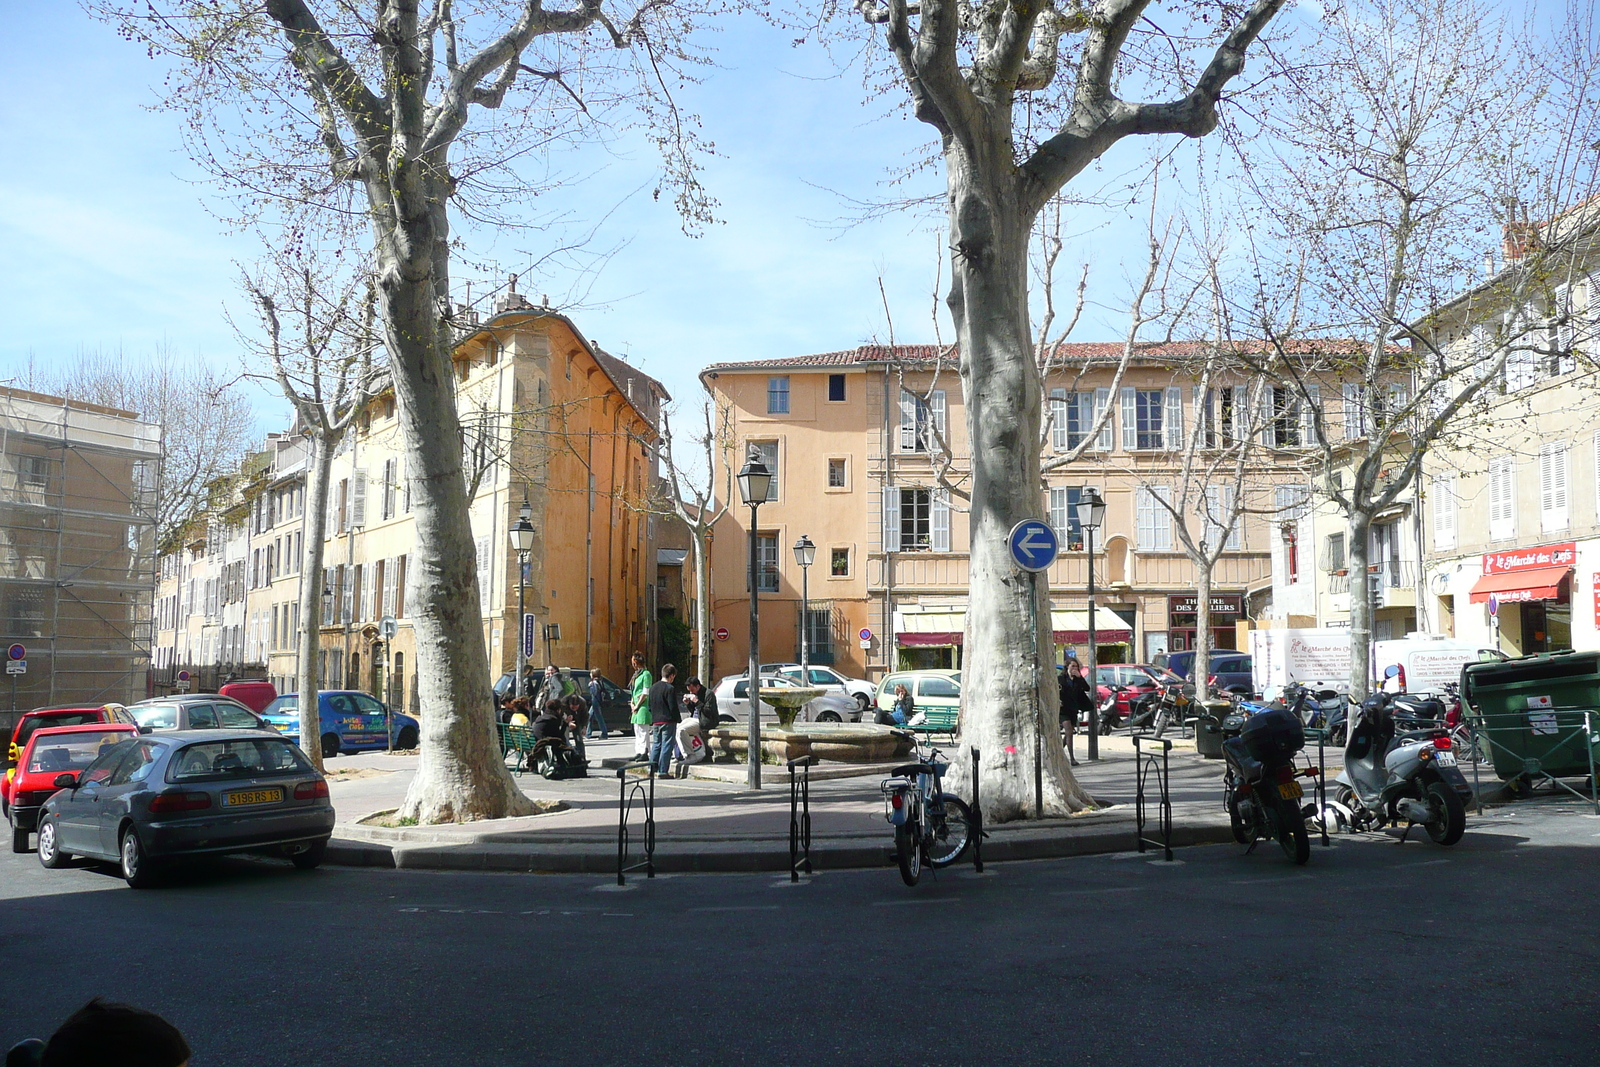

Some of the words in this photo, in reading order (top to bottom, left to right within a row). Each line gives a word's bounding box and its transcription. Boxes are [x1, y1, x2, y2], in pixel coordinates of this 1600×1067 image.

[1496, 555, 1504, 568] Le
[1504, 553, 1536, 569] Marché
[1536, 553, 1550, 563] des
[230, 792, 253, 804] 5196
[255, 791, 267, 802] RS
[269, 790, 280, 800] 13
